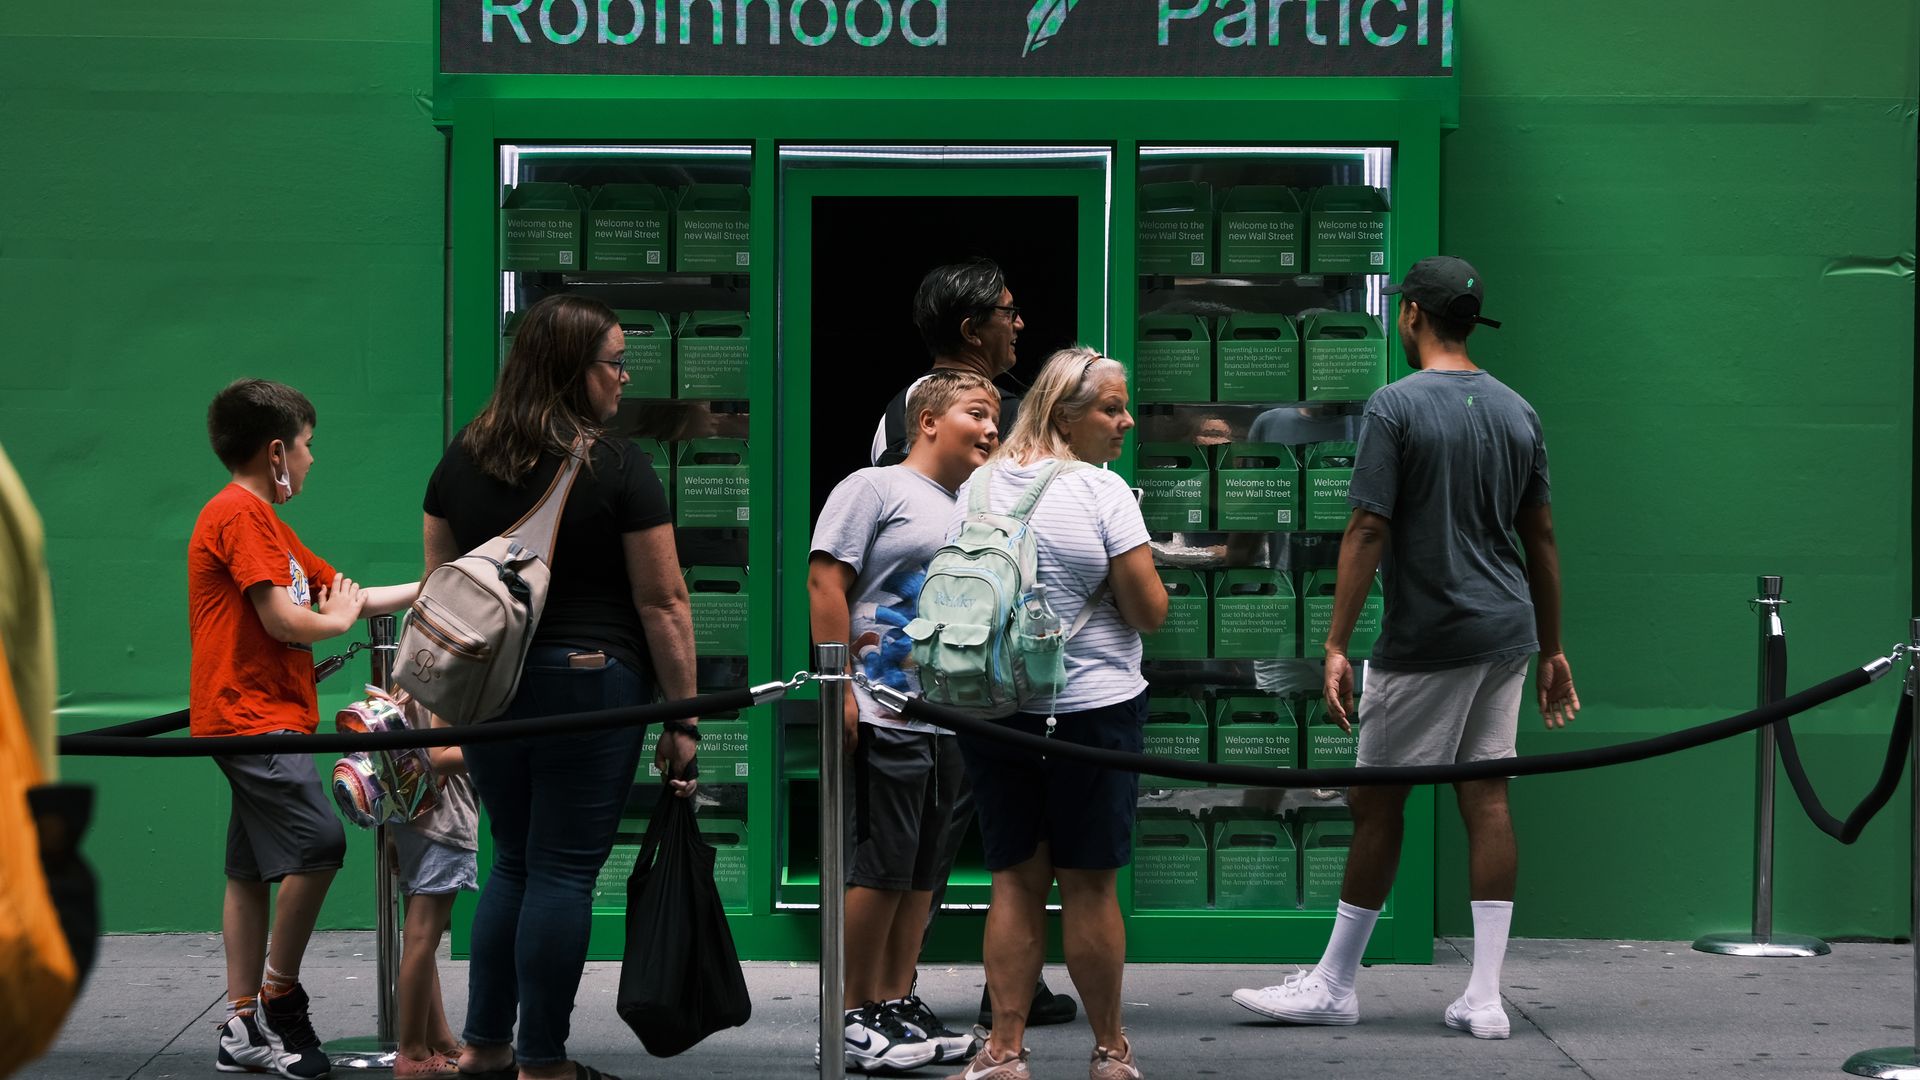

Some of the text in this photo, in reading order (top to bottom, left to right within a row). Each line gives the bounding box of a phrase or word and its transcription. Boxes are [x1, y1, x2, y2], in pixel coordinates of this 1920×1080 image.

[482, 0, 947, 46] Robinhood
[1157, 0, 1452, 67] Partici
[508, 219, 573, 228] Welcome to the
[595, 219, 660, 228] Welcome to the
[684, 221, 749, 230] Welcome to the
[1139, 221, 1204, 230] Welcome to the
[1228, 221, 1294, 230] Welcome to the
[1318, 220, 1384, 229] Welcome to the
[527, 230, 545, 239] Wall
[546, 230, 573, 239] Street
[614, 230, 632, 239] Wall
[634, 230, 660, 239] Street
[704, 232, 722, 240] Wall
[723, 232, 749, 240] Street
[1159, 232, 1177, 240] Wall
[1178, 232, 1204, 240] Street
[1248, 232, 1266, 240] Wall
[1268, 232, 1294, 240] Street
[1338, 231, 1356, 240] Wall
[1357, 231, 1384, 240] Street
[684, 476, 749, 485] Welcome to the
[1136, 479, 1202, 487] Welcome to the
[1225, 479, 1291, 487] Welcome to the
[704, 487, 722, 495] Wall
[724, 487, 749, 495] Street
[1156, 489, 1174, 498] Wall
[1175, 489, 1201, 498] Street
[1245, 490, 1263, 498] Wall
[1265, 490, 1291, 498] Street
[1333, 489, 1349, 497] Wal
[723, 733, 733, 741] to
[734, 733, 748, 741] the
[1143, 736, 1200, 744] elcome to the
[1224, 736, 1290, 744] Welcome to the
[1314, 736, 1353, 744] Welcome
[703, 743, 721, 751] Wall
[722, 743, 748, 751] Street
[1154, 746, 1172, 754] Wall
[1174, 746, 1200, 754] Street
[1244, 746, 1262, 754] Wall
[1264, 746, 1290, 754] Street
[1334, 746, 1352, 754] Wall
